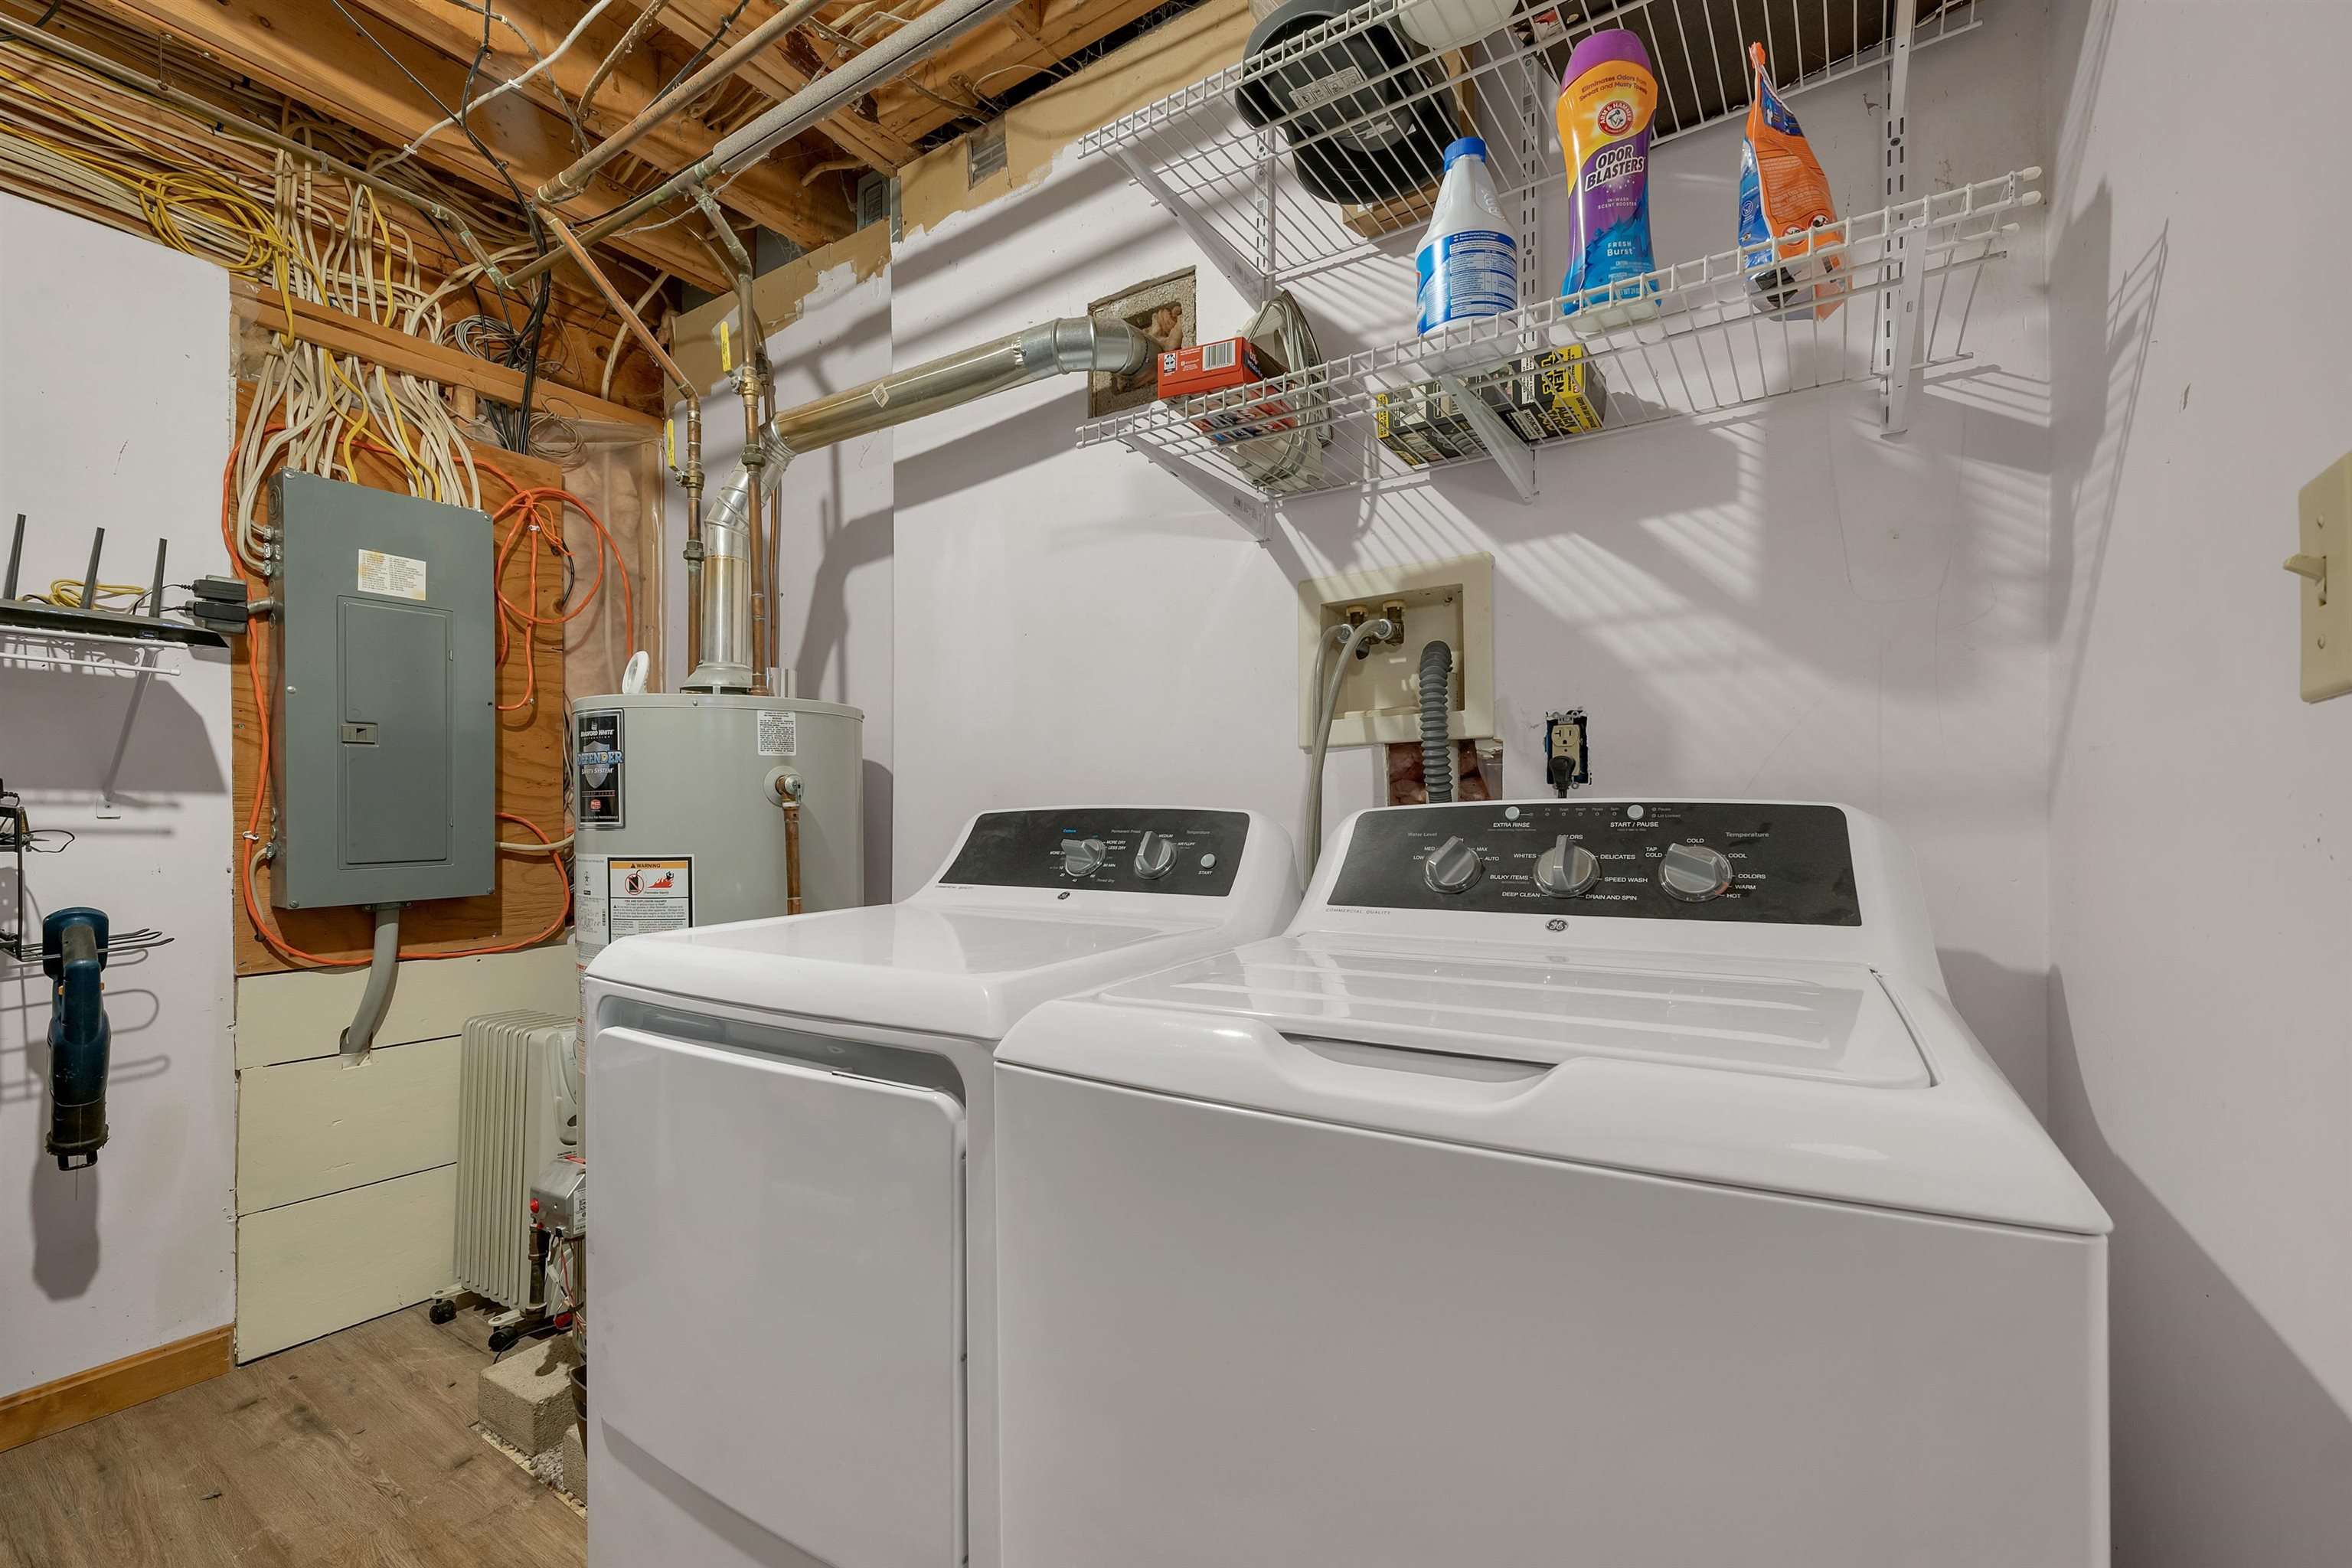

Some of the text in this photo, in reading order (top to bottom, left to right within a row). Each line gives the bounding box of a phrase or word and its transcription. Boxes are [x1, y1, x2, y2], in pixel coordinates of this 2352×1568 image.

[1579, 87, 1599, 102] Sweat
[1599, 81, 1614, 90] and
[1581, 76, 1615, 93] Eliminates
[1599, 109, 1609, 124] ARM
[1612, 102, 1632, 122] HAMMER
[1597, 145, 1634, 168] ODOR
[1586, 157, 1644, 190] BLASTERS
[1608, 240, 1632, 249] FRESH
[1557, 406, 1578, 430] ALIEN
[577, 751, 623, 765] DEFENDER
